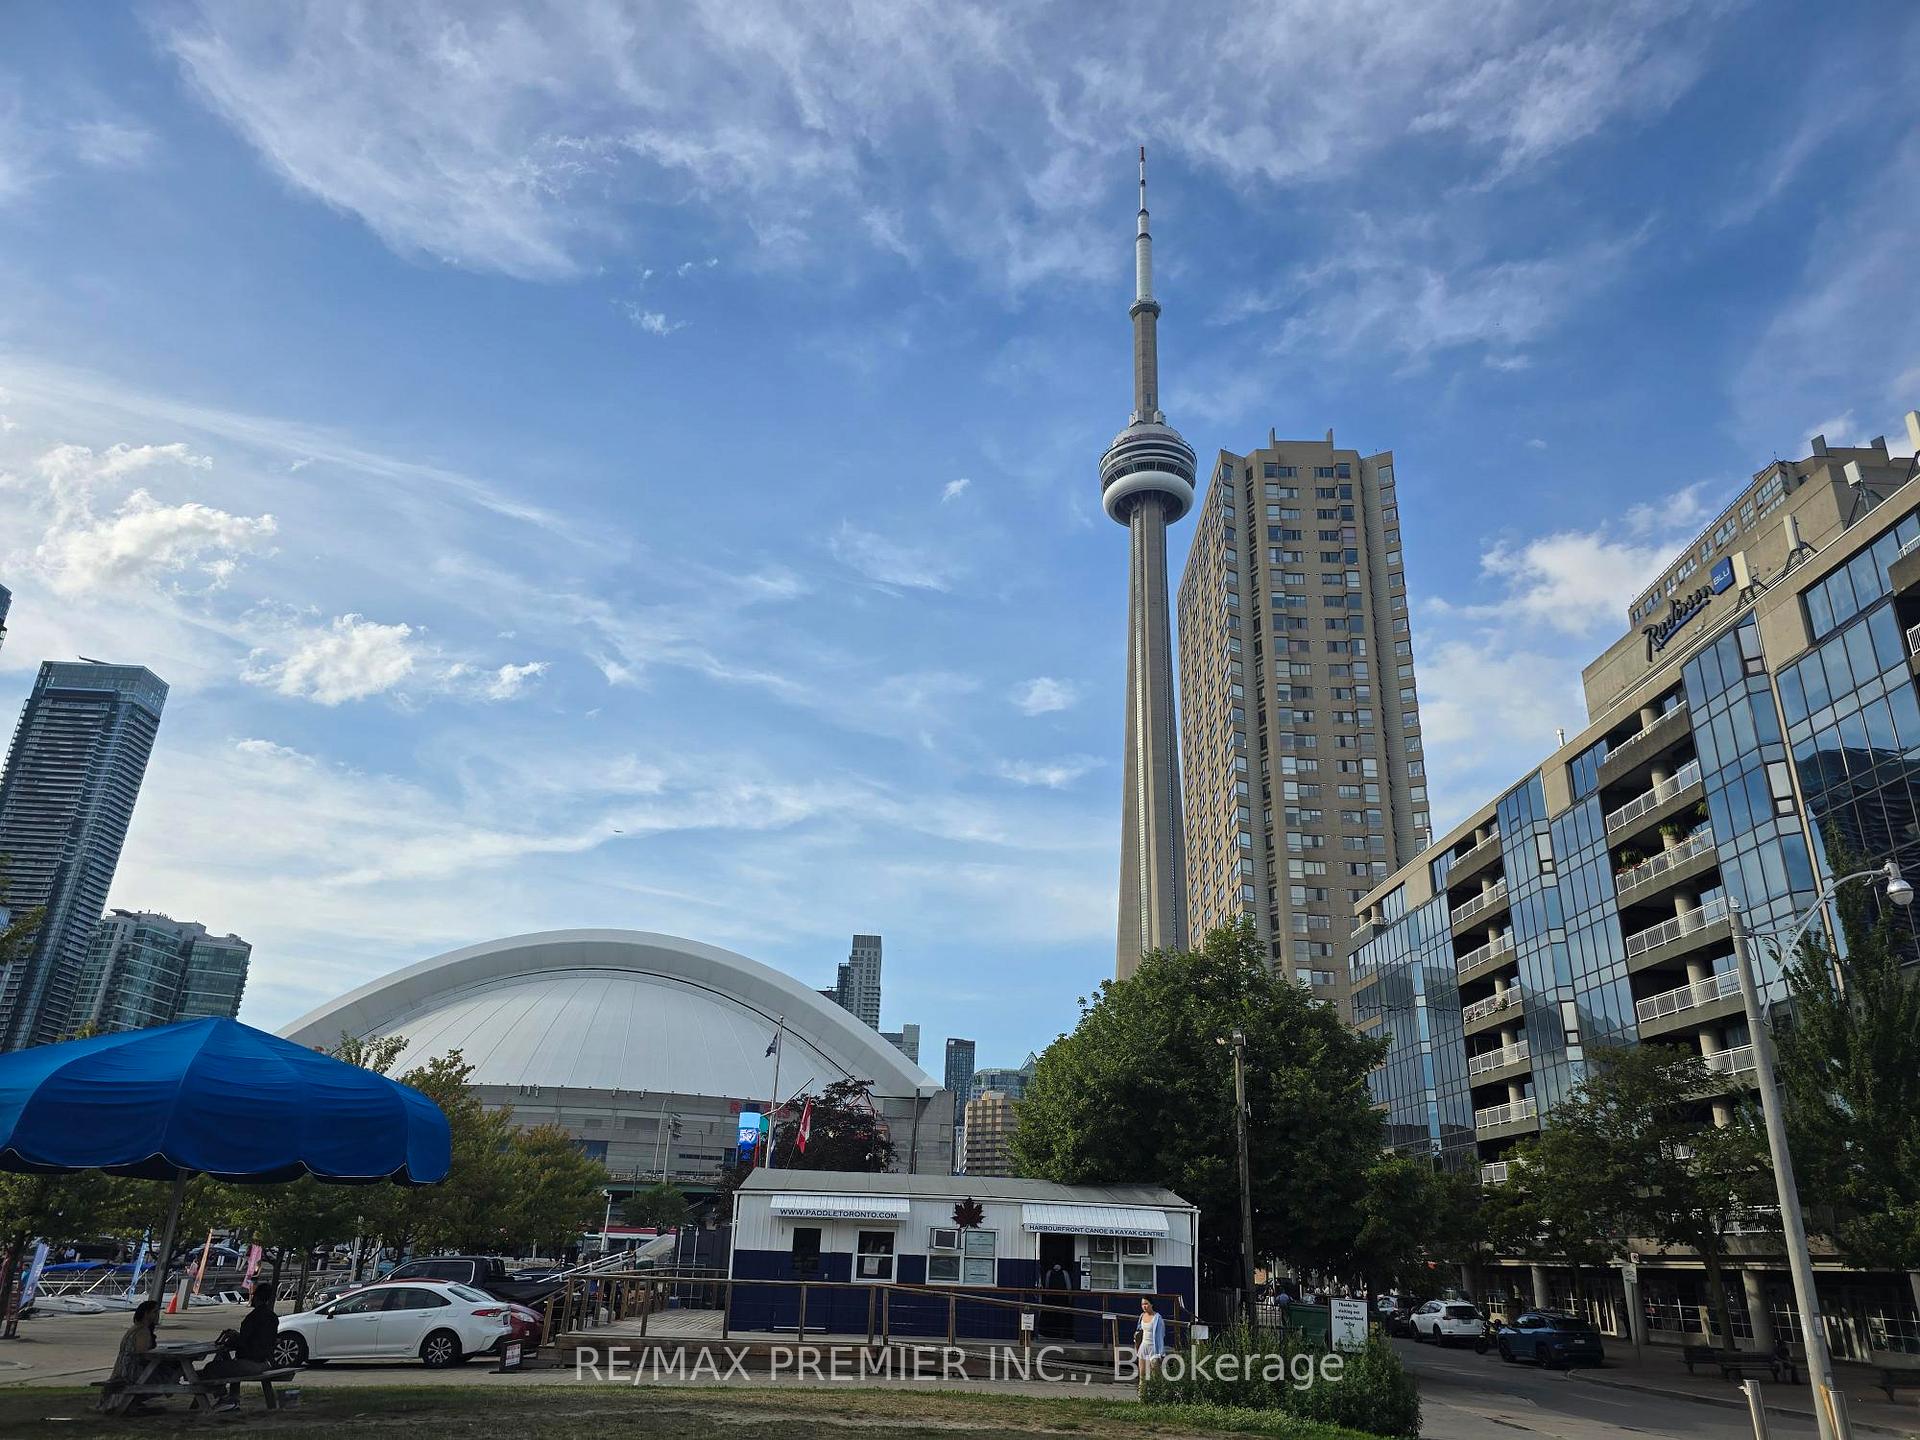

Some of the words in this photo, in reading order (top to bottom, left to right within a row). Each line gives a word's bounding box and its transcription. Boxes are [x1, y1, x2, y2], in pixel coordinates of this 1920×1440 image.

[1713, 568, 1730, 585] BLU
[1641, 584, 1715, 663] Radisson
[780, 1208, 898, 1219] WWW.PADDLETORONTO.COM
[1029, 1224, 1084, 1233] HARBOURFRONT
[1085, 1227, 1108, 1235] CANOE
